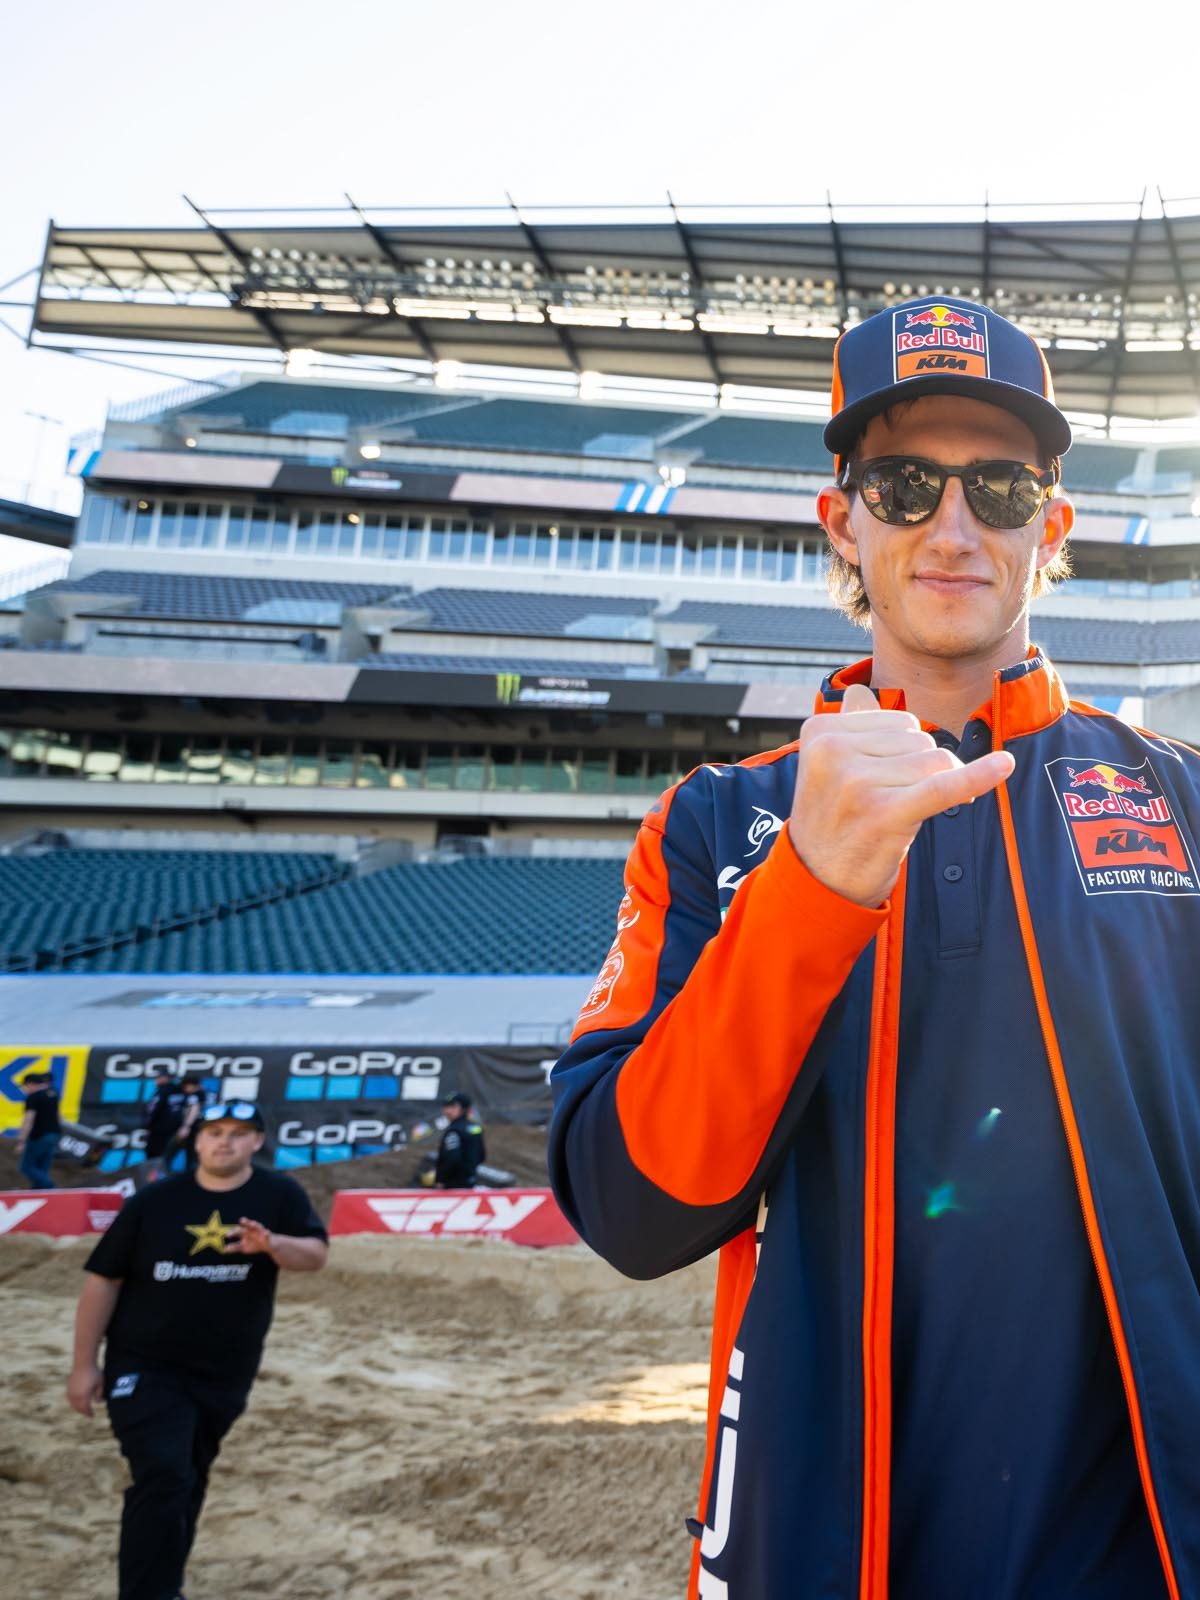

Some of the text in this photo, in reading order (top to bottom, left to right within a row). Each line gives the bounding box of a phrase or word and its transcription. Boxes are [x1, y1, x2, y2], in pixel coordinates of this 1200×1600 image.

[897, 327, 985, 353] Red Bull
[915, 354, 968, 371] KTM
[1063, 792, 1171, 822] Red Bull
[1095, 829, 1168, 858] KTM
[1087, 869, 1194, 889] FACTORY RACING
[105, 1053, 263, 1078] GoPro
[290, 1052, 442, 1077] GoPro
[278, 1120, 407, 1146] GoPr
[367, 1195, 547, 1232] FLY
